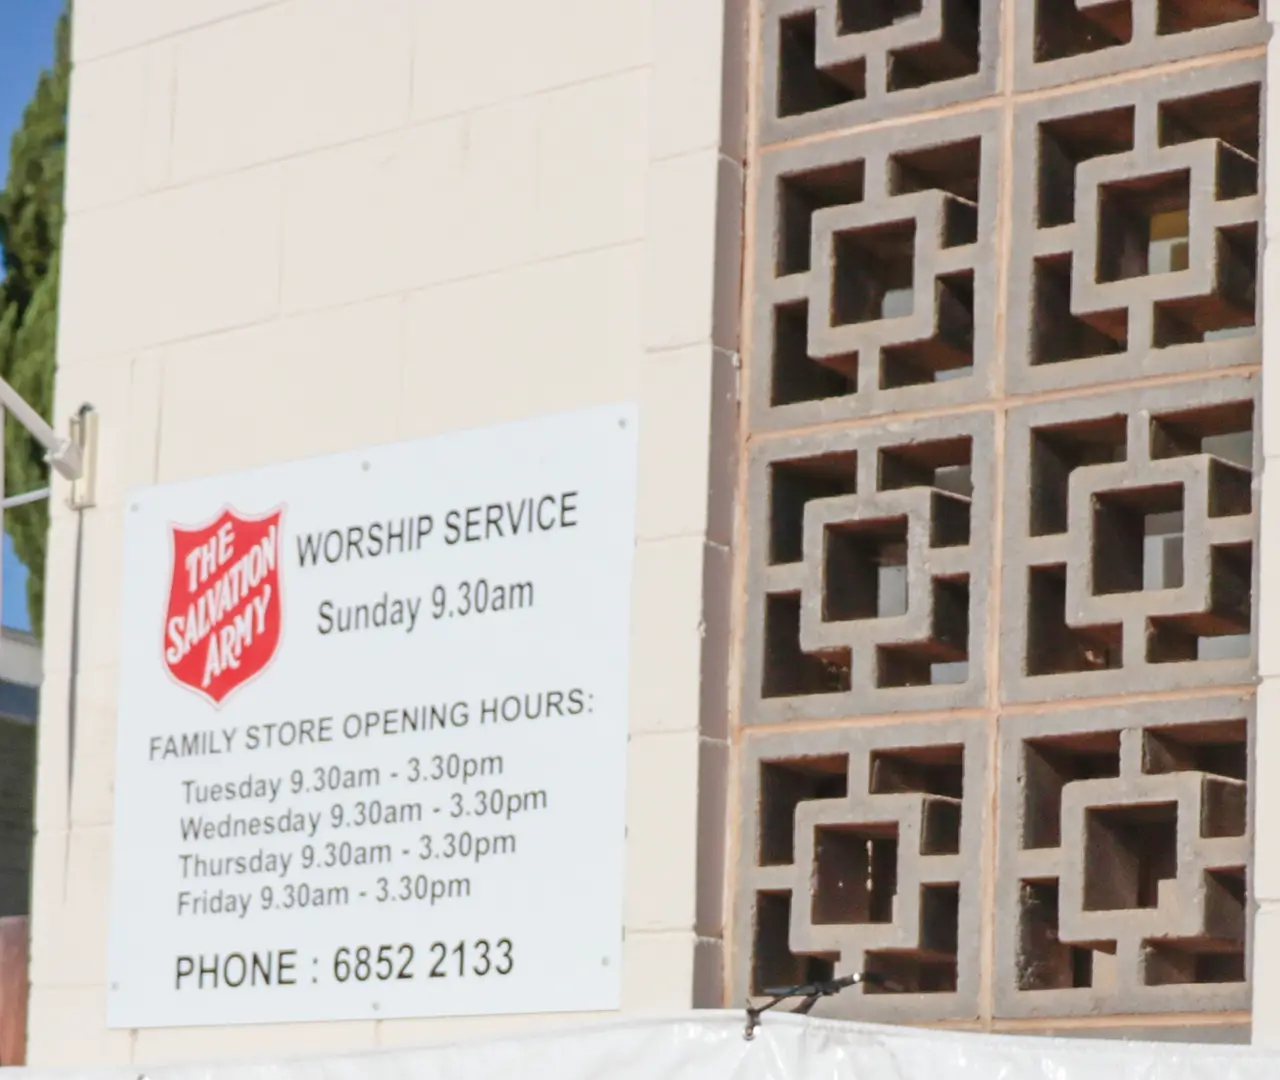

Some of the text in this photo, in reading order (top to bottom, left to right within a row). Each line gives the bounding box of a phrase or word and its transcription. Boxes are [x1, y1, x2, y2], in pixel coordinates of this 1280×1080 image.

[185, 520, 235, 594] THE
[295, 491, 580, 568] WORSHIP SERVICE
[166, 524, 277, 665] SALVATION
[317, 577, 535, 635] Sunday 9.30am
[201, 583, 272, 688] ARMY
[148, 688, 595, 761] FAMILY STORE OPENING HOURS:
[182, 774, 281, 805] Tuesday
[290, 764, 380, 795] 9.30am
[406, 753, 504, 788] 3.30pm
[180, 805, 321, 842] Wednesday
[330, 799, 422, 830] 9.30am
[449, 787, 548, 824] 3.30pm
[178, 848, 293, 879] Thursday
[300, 839, 392, 870] 9.30am
[418, 830, 517, 865] 3.30pm
[176, 888, 252, 919] Friday
[260, 881, 350, 911] 9.30am
[375, 873, 472, 904] 3.30pm
[175, 949, 298, 990] PHONE
[332, 941, 416, 984] 6852
[428, 937, 515, 978] 2133
